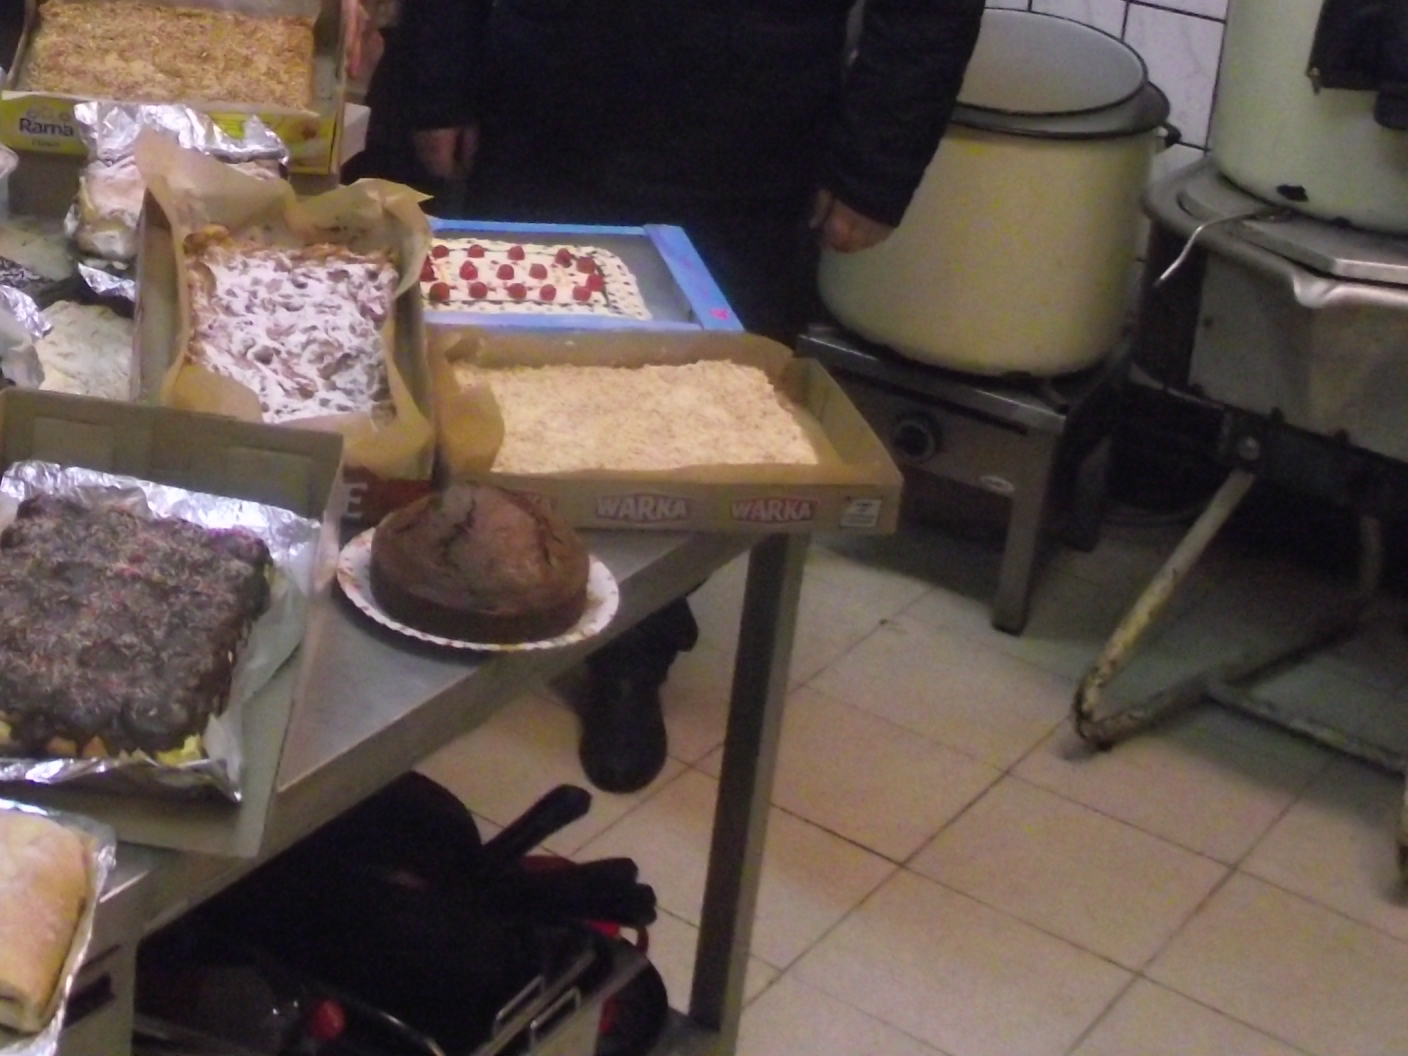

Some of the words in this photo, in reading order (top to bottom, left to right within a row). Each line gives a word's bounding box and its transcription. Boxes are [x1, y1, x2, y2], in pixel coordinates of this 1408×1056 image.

[18, 117, 74, 137] Rama
[596, 495, 688, 521] WARKA
[731, 498, 813, 522] WARKA
